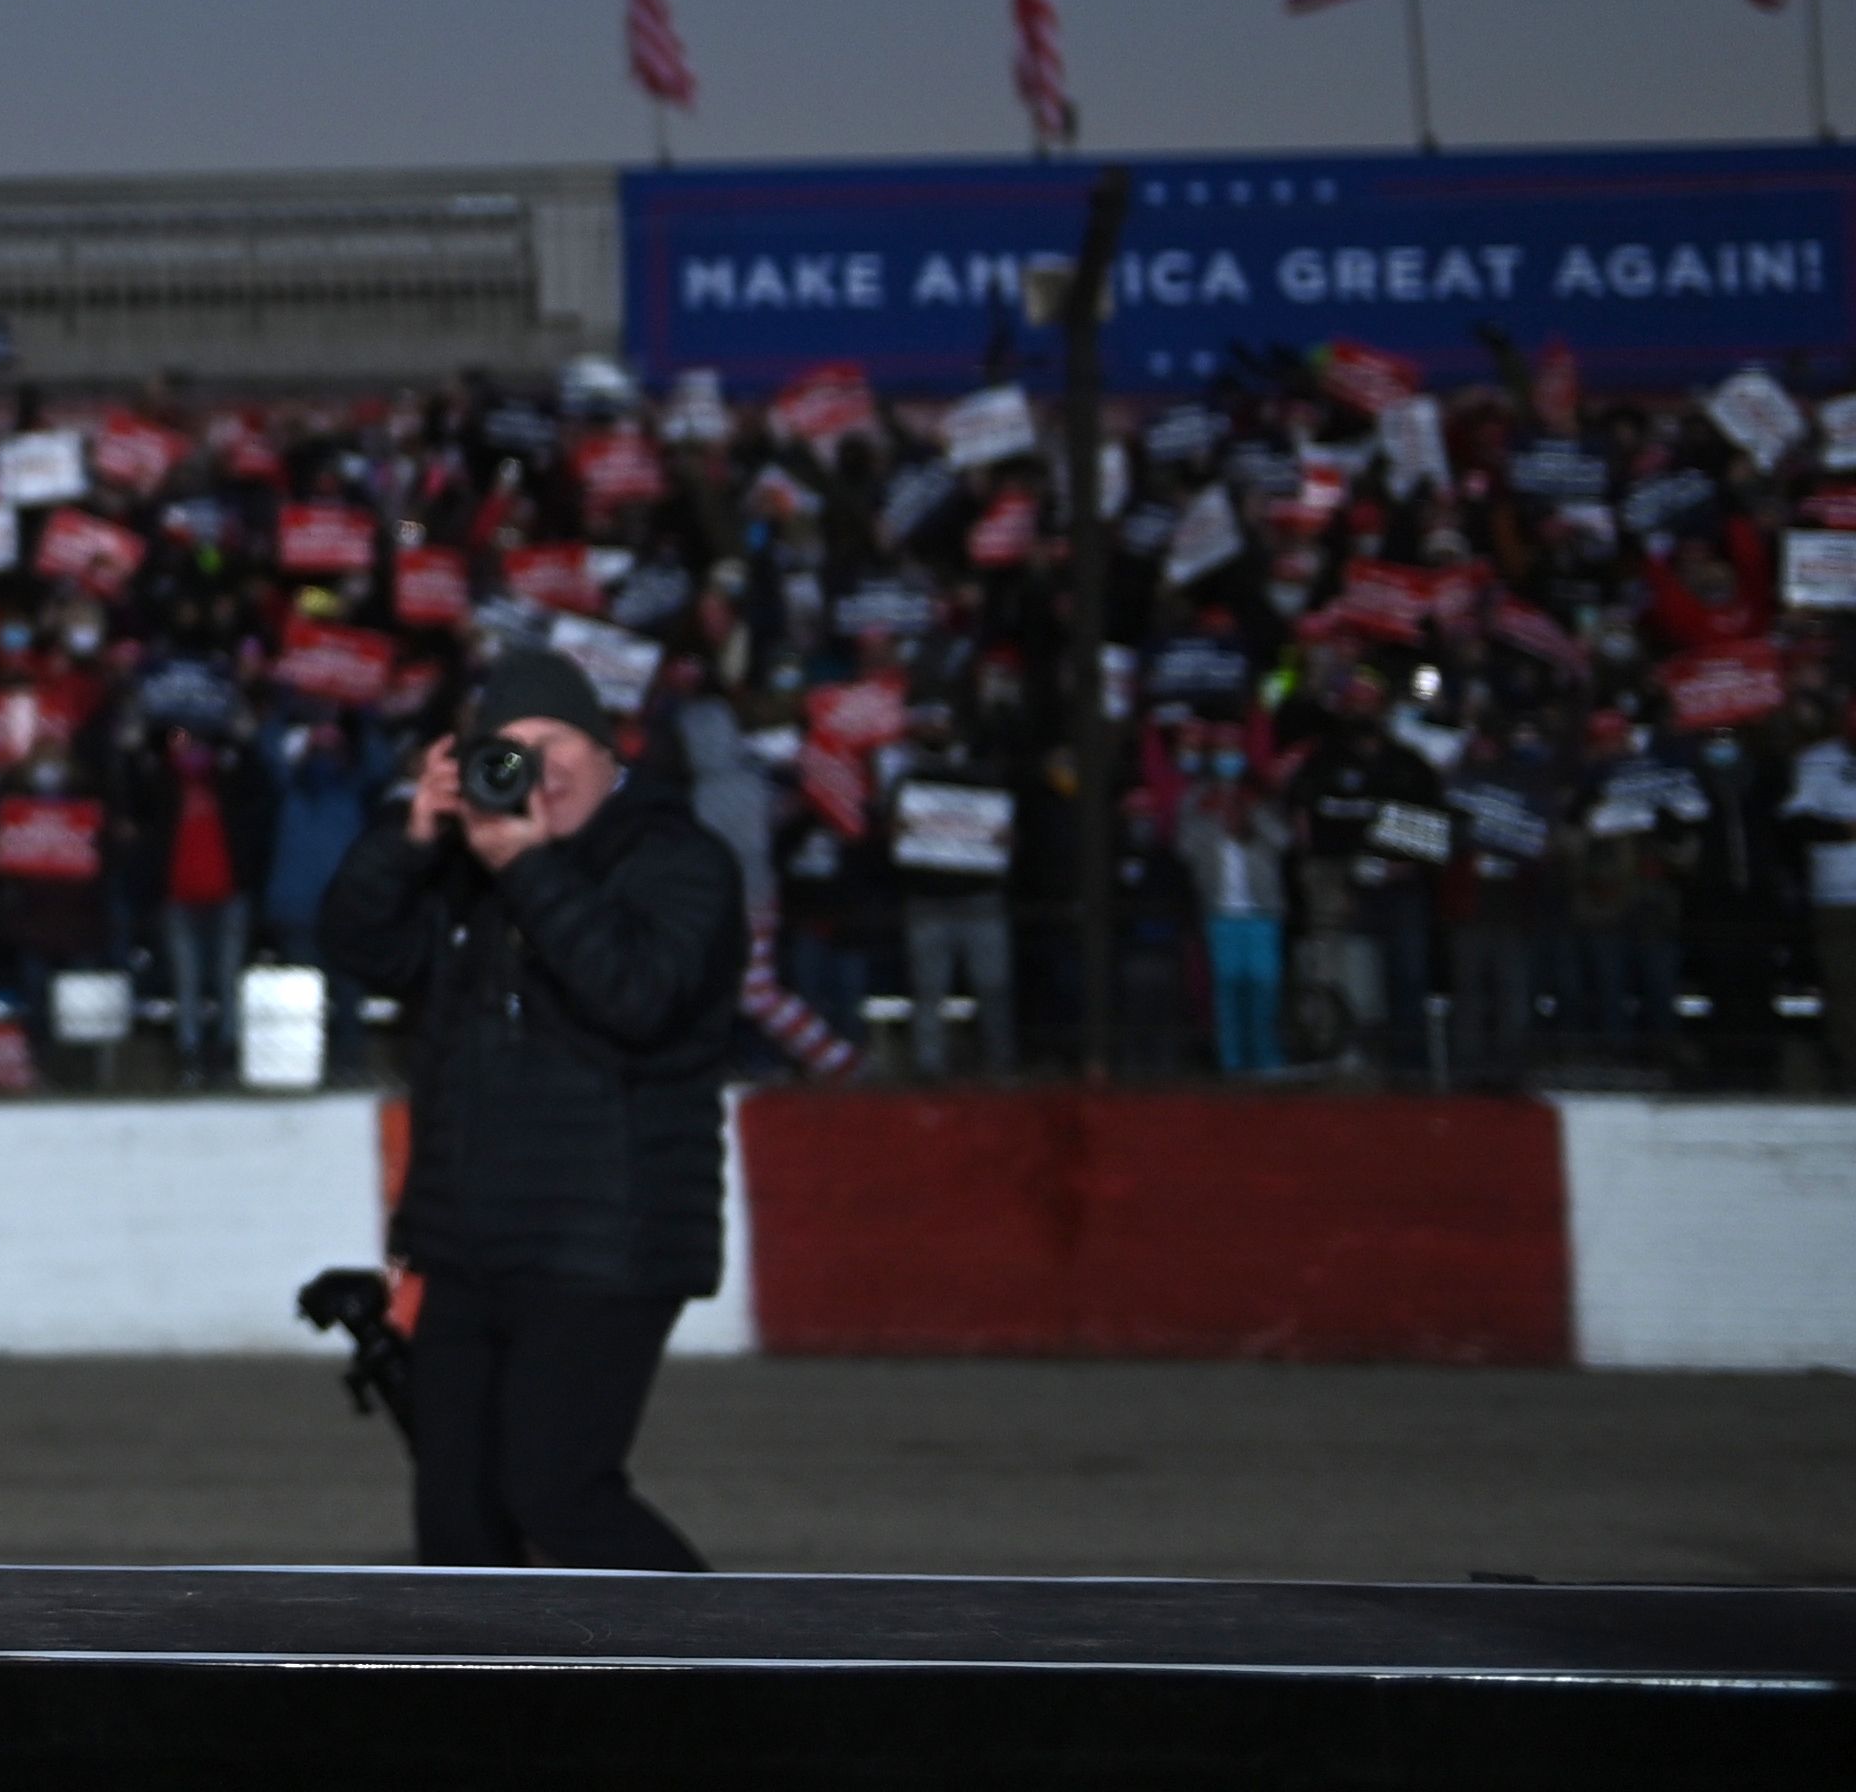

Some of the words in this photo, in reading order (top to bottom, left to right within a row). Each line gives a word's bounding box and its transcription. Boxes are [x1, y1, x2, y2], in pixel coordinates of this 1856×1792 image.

[683, 251, 888, 308] MAKE
[912, 248, 1250, 306] AMICA
[1275, 244, 1525, 304] GREAT
[1552, 239, 1823, 299] AGAIN!
